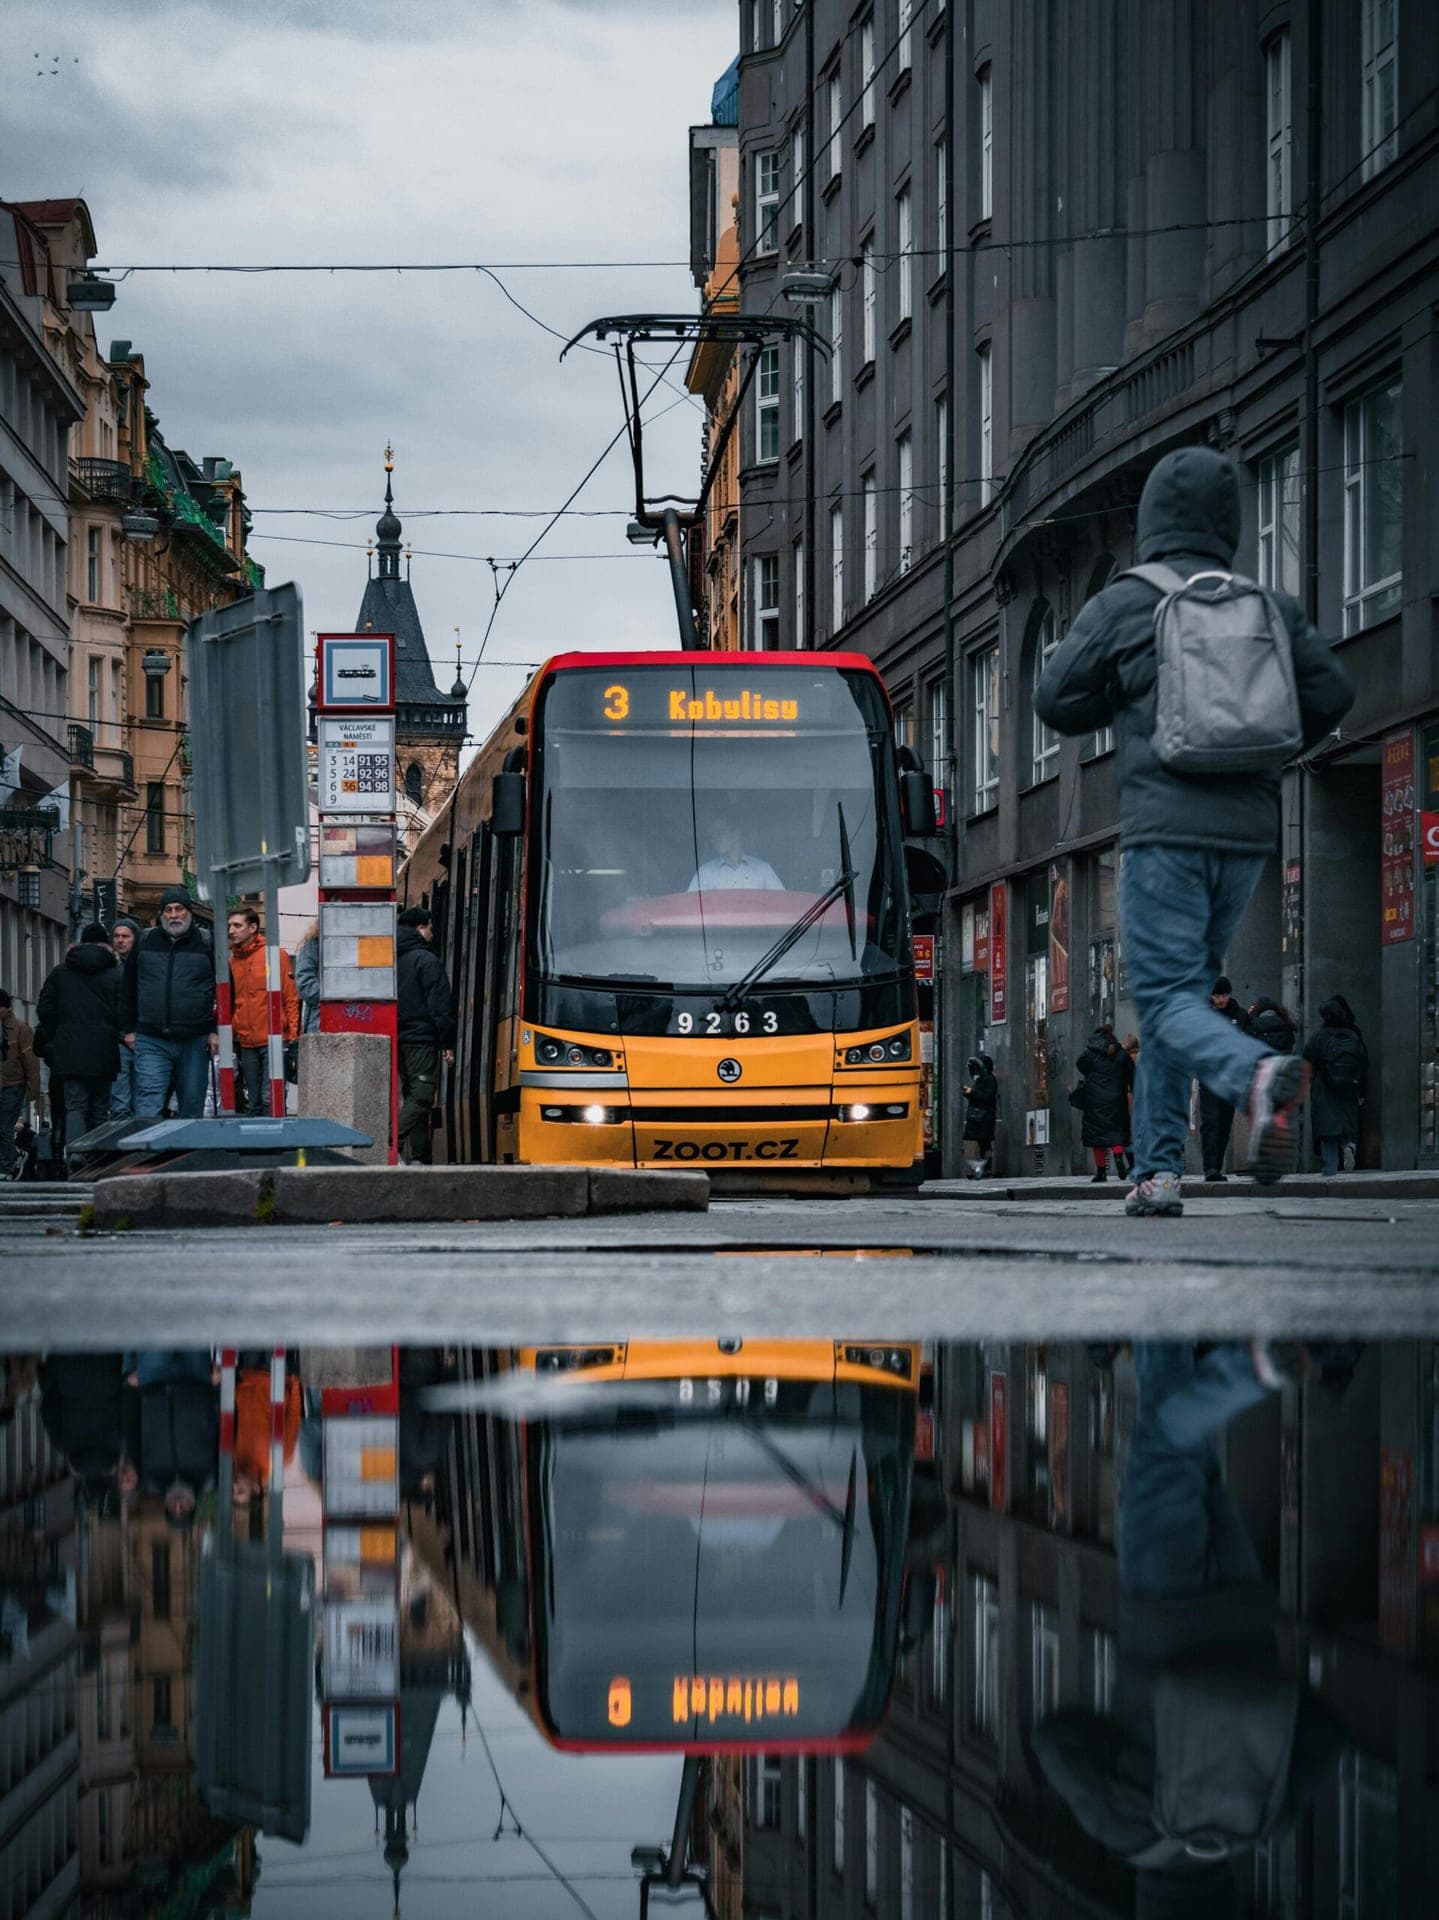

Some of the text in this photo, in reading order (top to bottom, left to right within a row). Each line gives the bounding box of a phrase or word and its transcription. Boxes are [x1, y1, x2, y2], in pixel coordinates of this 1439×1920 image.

[604, 685, 798, 720] 3 Kobylisy
[330, 756, 388, 766] 3 14 91 95
[330, 768, 388, 778] 5 24 92 96
[330, 782, 388, 792] 6 36 94 98
[330, 794, 336, 804] 9
[653, 1139, 799, 1160] ZOOT.CZ
